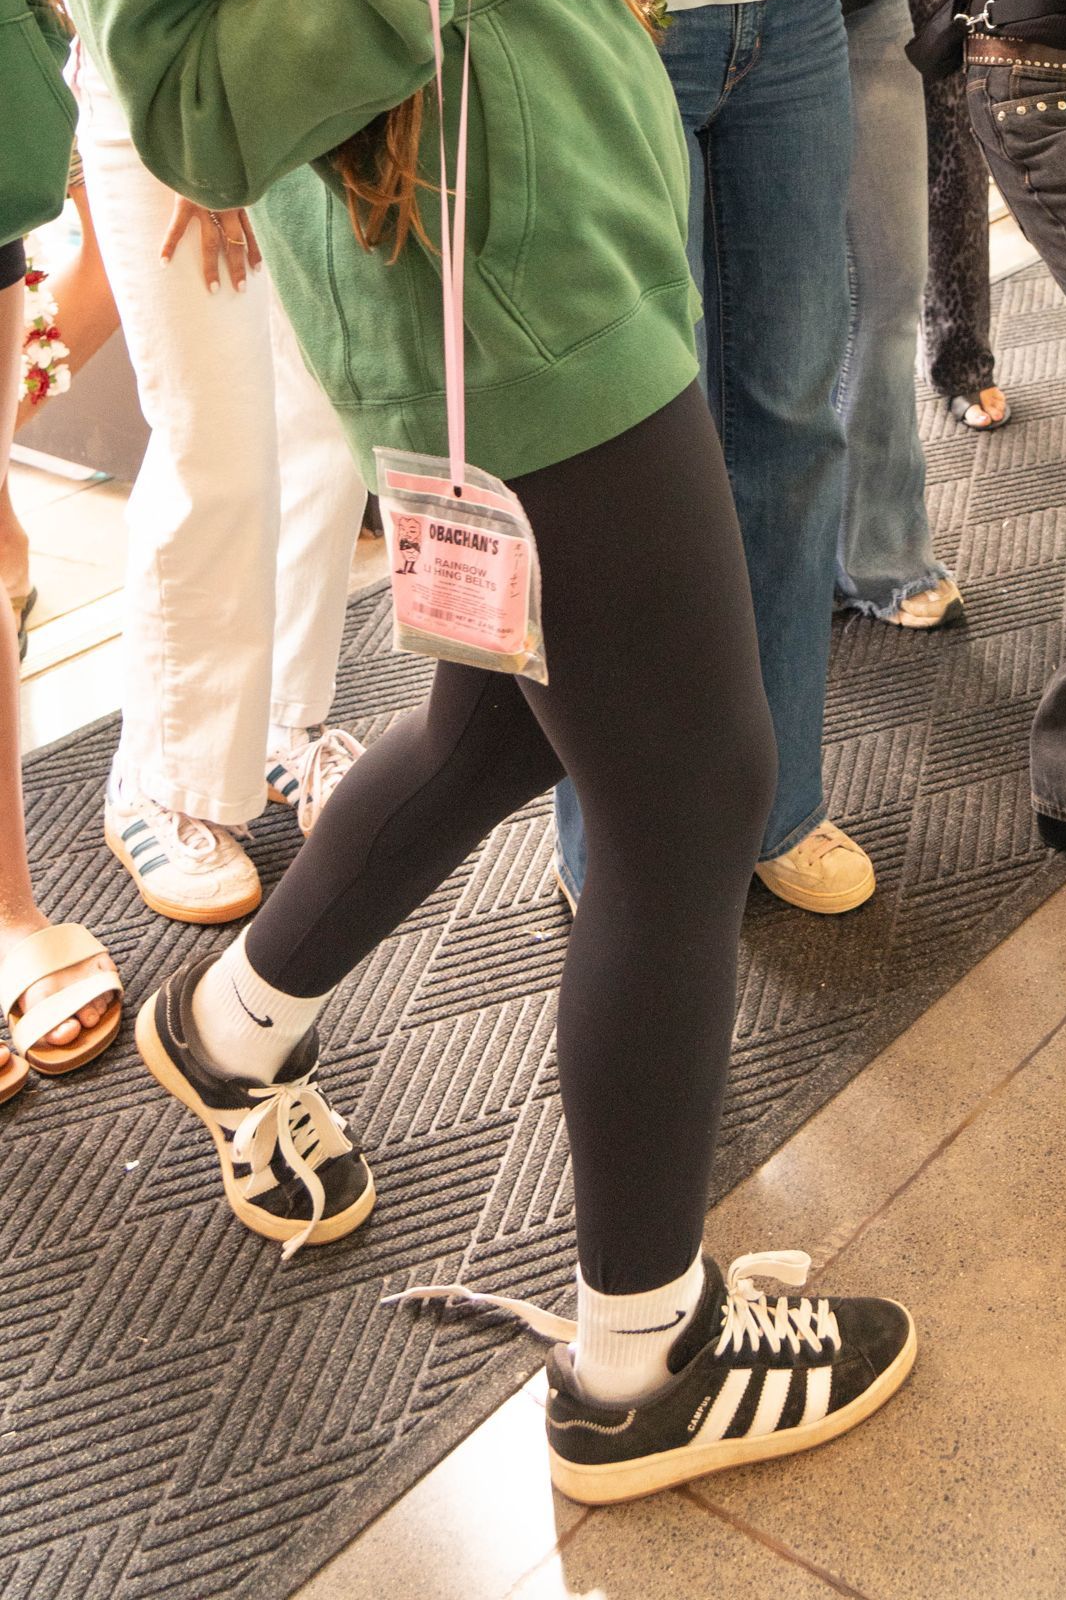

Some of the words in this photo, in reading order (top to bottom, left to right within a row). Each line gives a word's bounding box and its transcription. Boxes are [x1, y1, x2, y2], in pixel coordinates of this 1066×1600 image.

[429, 523, 499, 555] OBACHAN'S
[434, 557, 487, 578] RAINBOW
[434, 567, 462, 581] HING
[465, 574, 497, 592] BELTS
[687, 1395, 712, 1432] CAMPUS
